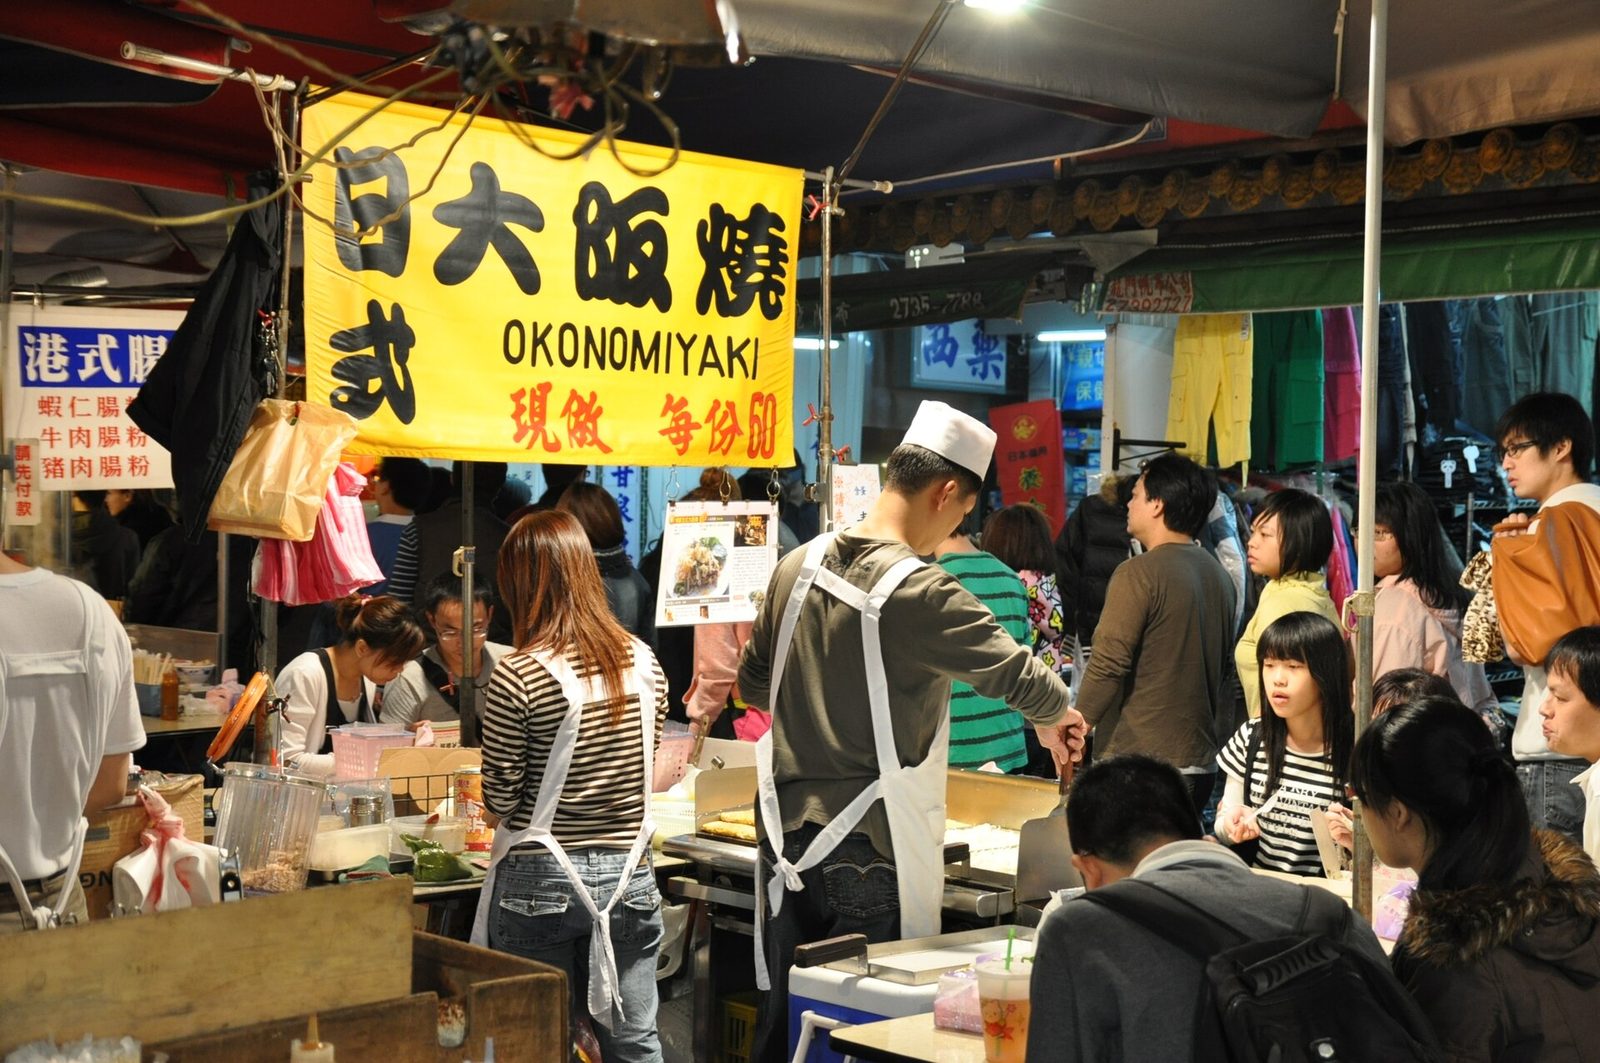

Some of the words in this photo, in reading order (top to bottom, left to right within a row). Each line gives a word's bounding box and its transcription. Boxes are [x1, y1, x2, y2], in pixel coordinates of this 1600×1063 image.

[433, 161, 790, 320] 大阪燒
[329, 145, 416, 425] 日式
[503, 319, 759, 380] OKONOMIYAKI
[38, 395, 138, 418] 蝦仁腸
[40, 426, 149, 449] 牛肉腸粉
[41, 455, 150, 479] 豬肉腸粉
[15, 445, 32, 517] 請先付款
